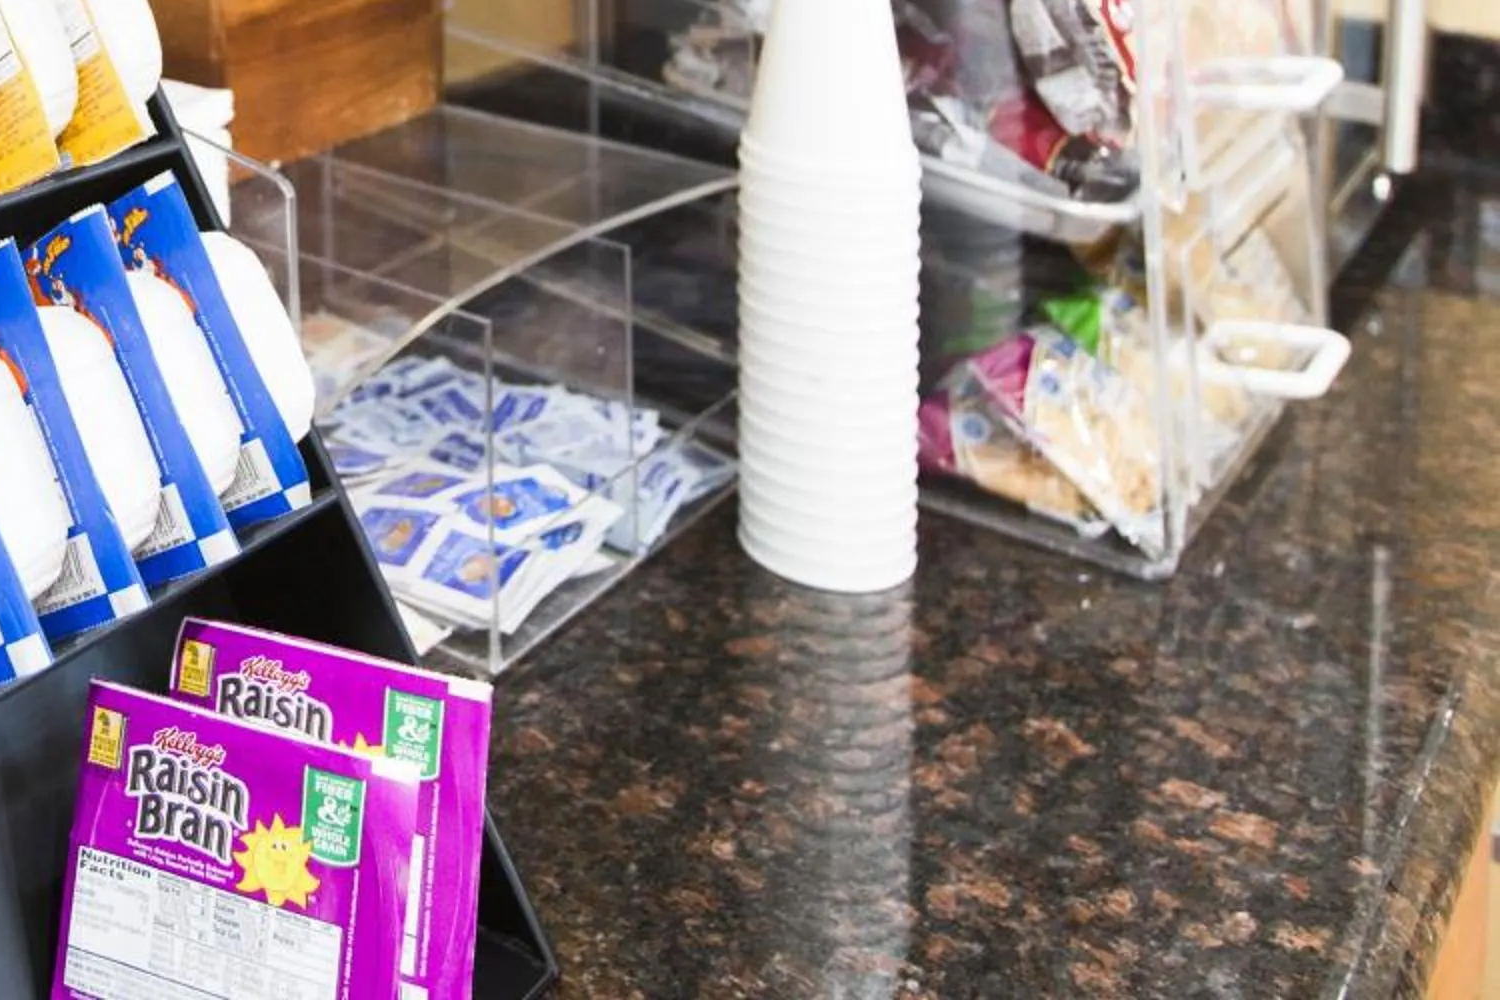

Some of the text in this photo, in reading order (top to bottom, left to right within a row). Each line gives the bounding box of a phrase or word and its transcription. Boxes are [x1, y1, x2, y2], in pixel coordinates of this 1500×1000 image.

[241, 655, 312, 691] Kellogg's
[218, 675, 327, 742] Raisin
[154, 727, 226, 766] Kellogg's
[128, 747, 245, 829] Raisin
[138, 793, 229, 864] Bran
[80, 848, 152, 879] Nutrition
[80, 860, 125, 881] Facts
